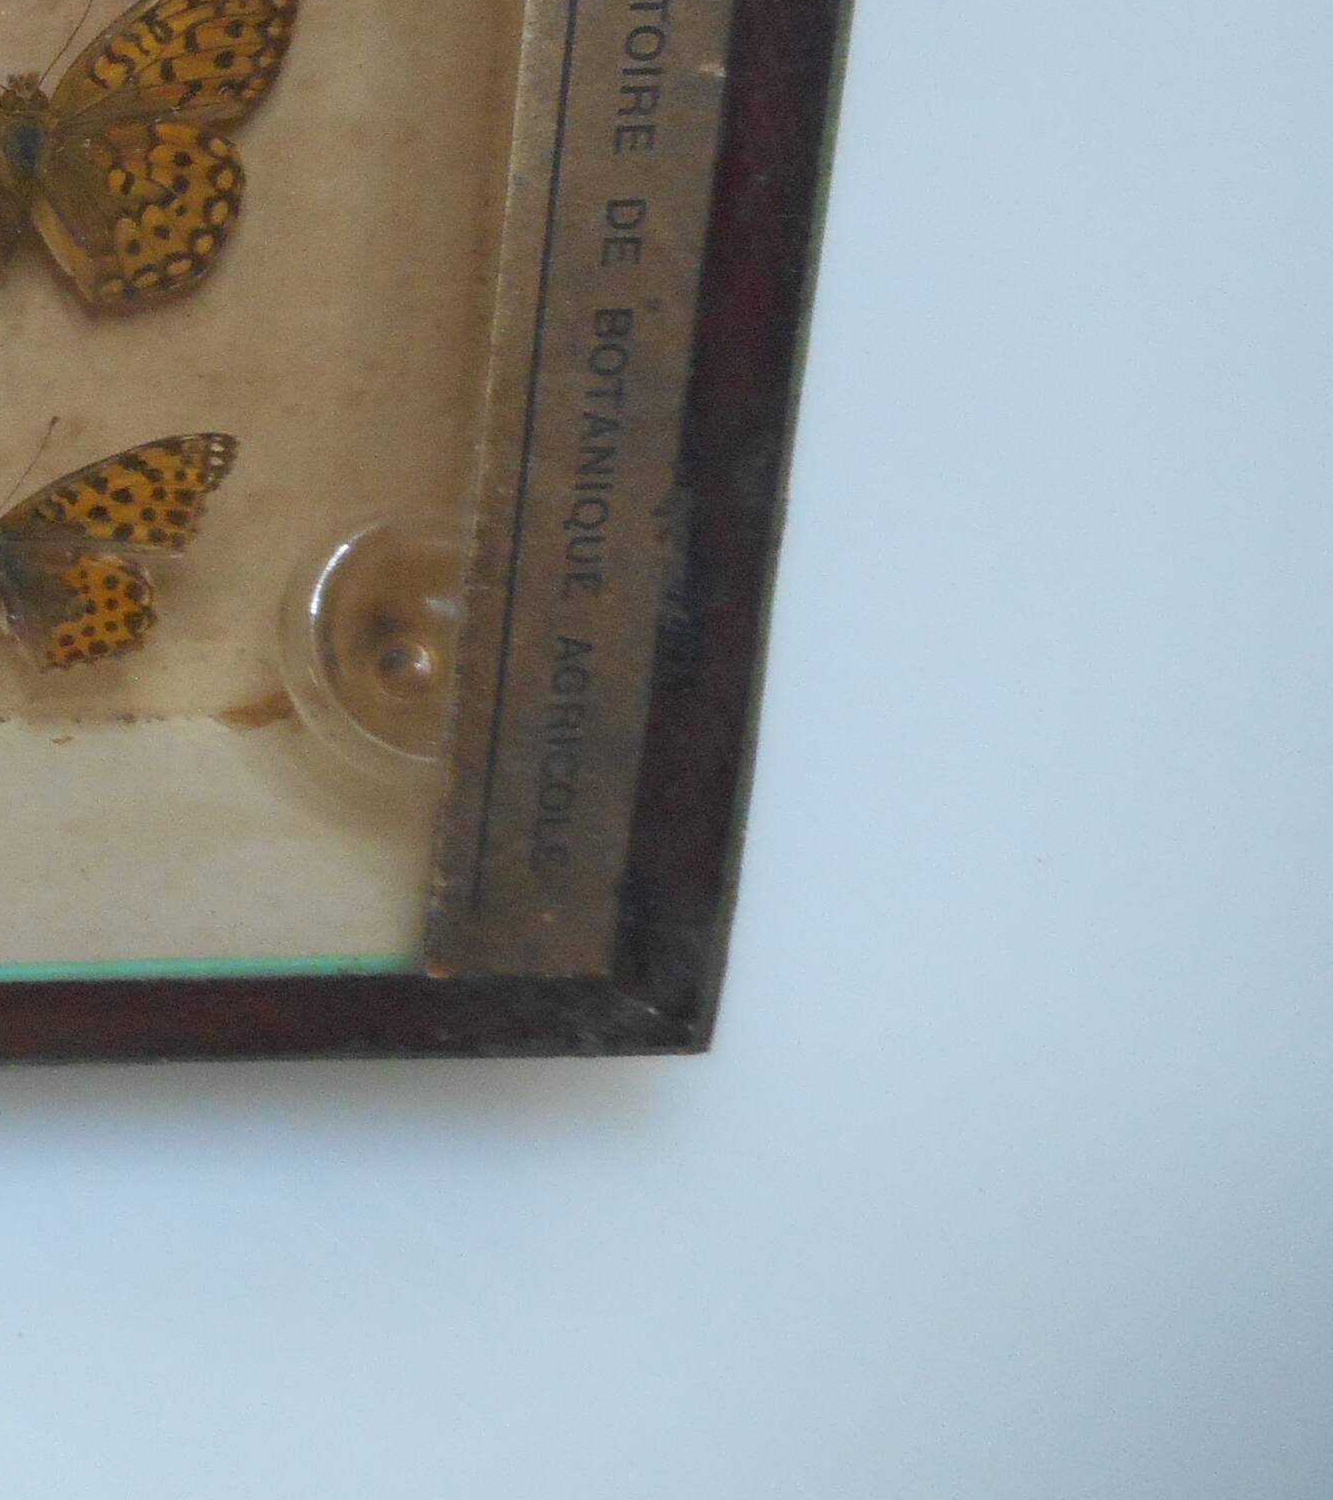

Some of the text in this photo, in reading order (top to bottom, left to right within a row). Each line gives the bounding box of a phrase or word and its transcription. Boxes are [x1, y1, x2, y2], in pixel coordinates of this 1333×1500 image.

[601, 198, 648, 268] DE
[562, 308, 634, 598] BOTANIQUE
[531, 635, 597, 872] AGRICOLE
